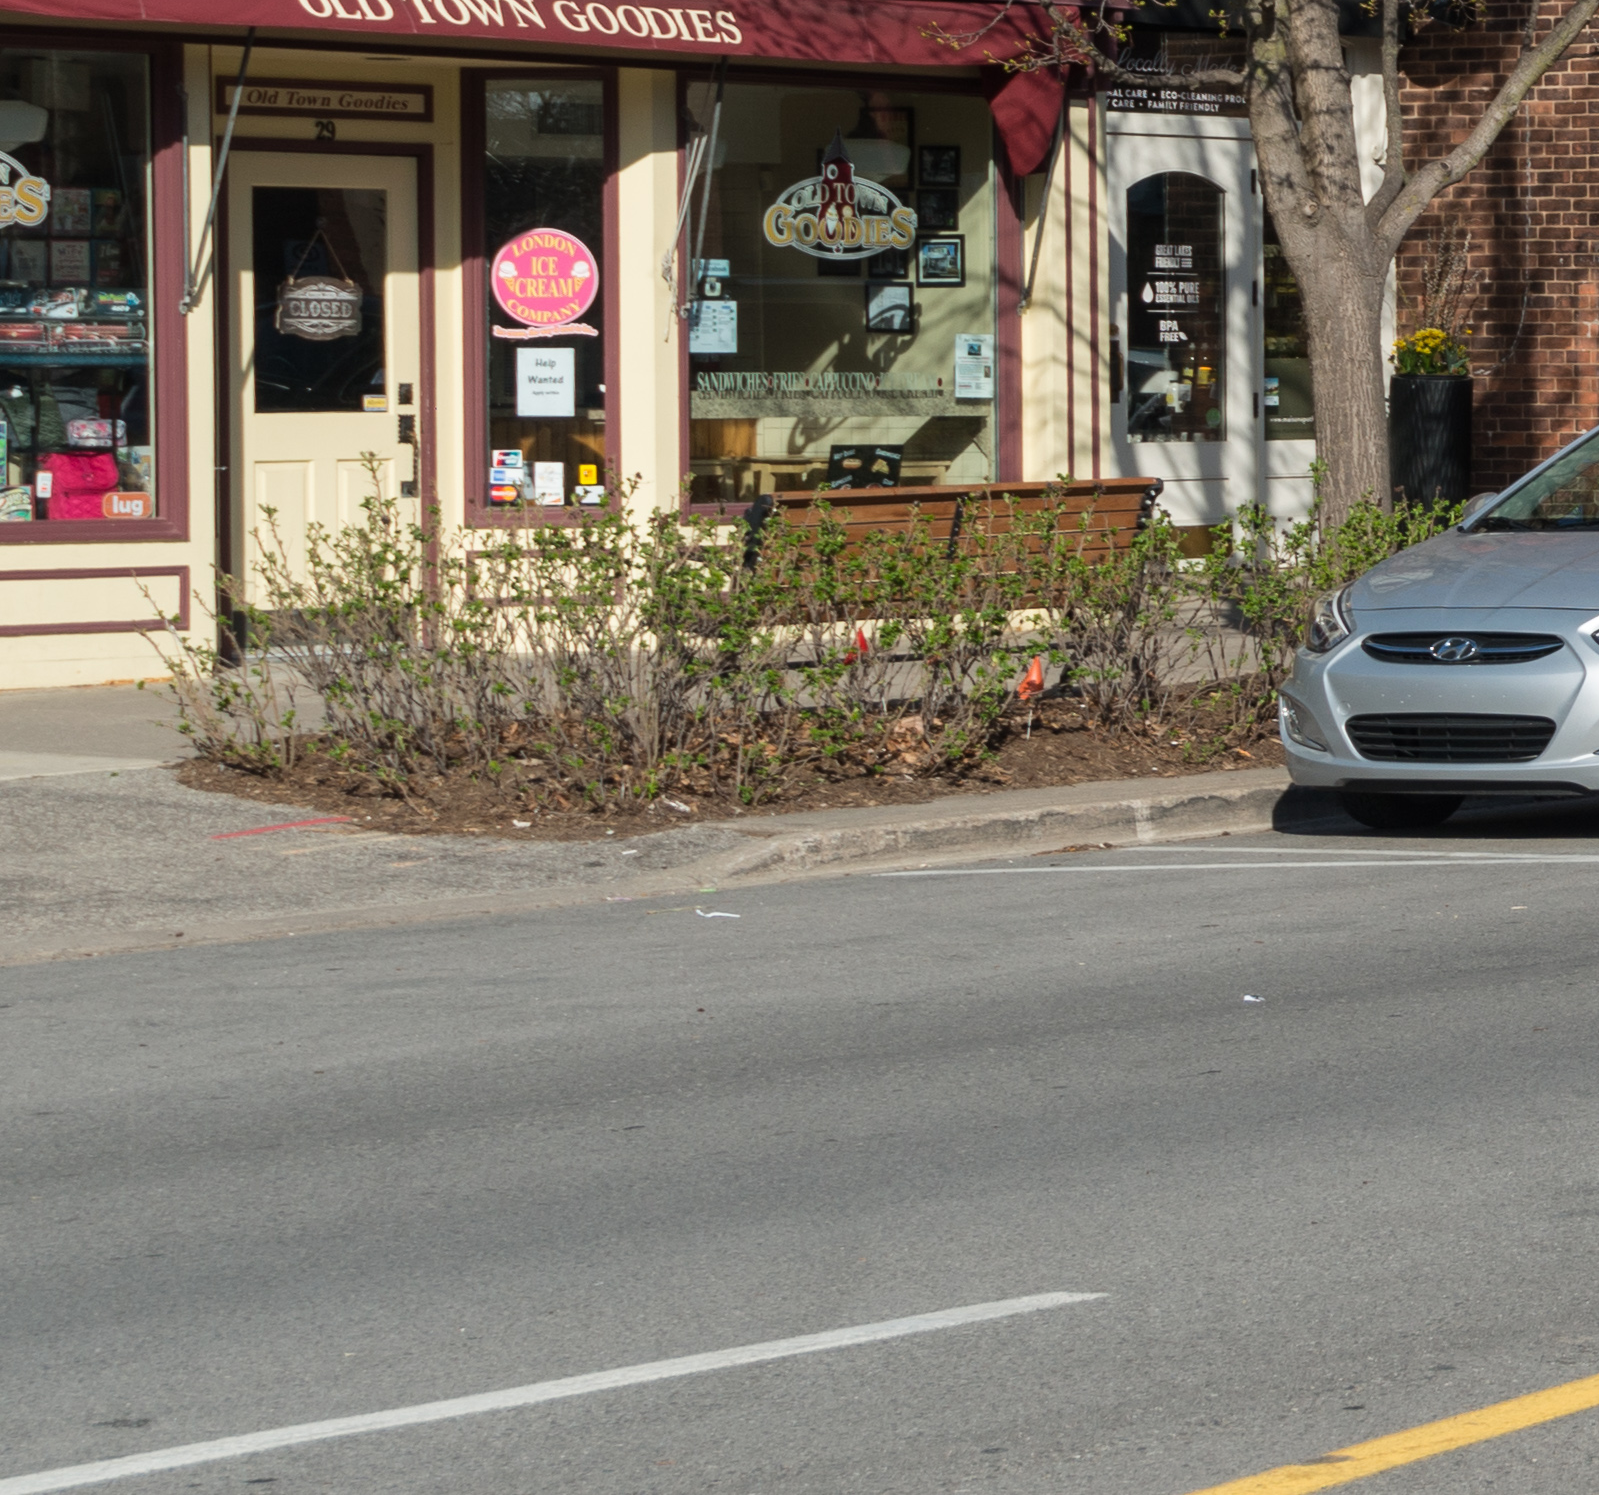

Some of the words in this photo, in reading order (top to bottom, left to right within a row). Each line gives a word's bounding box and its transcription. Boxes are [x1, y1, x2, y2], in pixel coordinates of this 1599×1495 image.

[553, 0, 743, 45] GOODIES
[1117, 47, 1176, 77] Locally
[1181, 53, 1238, 76] Made
[247, 89, 279, 106] Old
[286, 90, 331, 107] Town
[338, 93, 409, 111] Goodies
[1112, 99, 1135, 108] CARE
[1148, 100, 1177, 110] FAMILY
[1179, 101, 1219, 112] FRIENDLY
[1125, 90, 1148, 98] CARE
[1160, 91, 1222, 102] ECO-CLEANING
[315, 120, 336, 141] 29
[791, 183, 830, 210] OLD
[833, 183, 888, 213] TOWN
[763, 203, 918, 249] GOODIES
[512, 233, 577, 258] LONDON
[531, 256, 558, 277] ICE
[515, 276, 574, 299] CREAM
[1155, 281, 1177, 294] 100%
[1179, 281, 1199, 294] PURE
[289, 300, 353, 319] CLOSED
[507, 298, 582, 324] COMPANY
[1159, 319, 1179, 332] BPA
[1160, 332, 1180, 342] FREE
[535, 358, 557, 369] Help
[528, 375, 564, 385] Wanted
[697, 371, 769, 391] SANDWICHES
[773, 371, 805, 390] FRIES
[809, 371, 875, 391] CAPPUCCINO
[112, 495, 144, 516] lug
